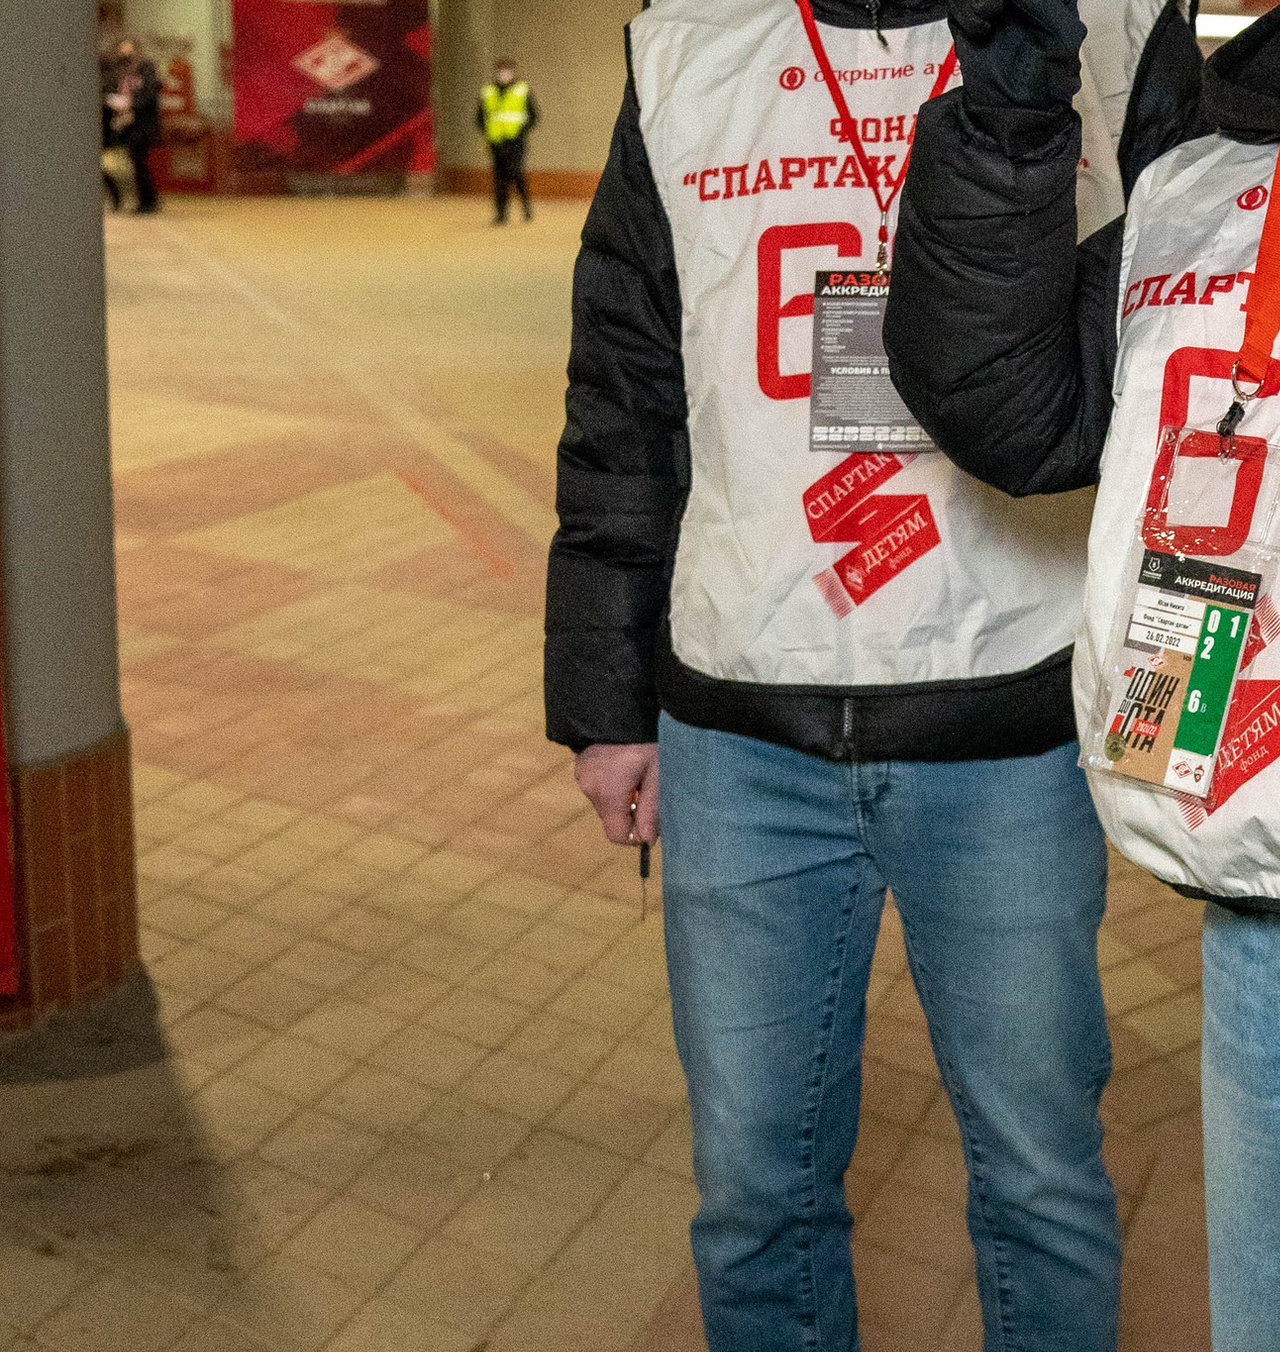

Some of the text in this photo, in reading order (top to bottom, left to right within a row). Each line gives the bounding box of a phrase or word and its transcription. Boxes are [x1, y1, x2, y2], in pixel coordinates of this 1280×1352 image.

[814, 62, 915, 85] окрытие
[829, 273, 892, 286] РАЗО
[862, 511, 928, 574] ДЕТЯМ
[1174, 576, 1254, 601] АККРЕДИТАЦИЯ
[1208, 574, 1257, 593] РАЗОВАЯ
[1145, 630, 1181, 647] 26.02.2022
[1231, 615, 1241, 639] 1
[1200, 635, 1215, 660] 2
[1126, 667, 1180, 709] ОДИН
[1239, 745, 1270, 773] фонд
